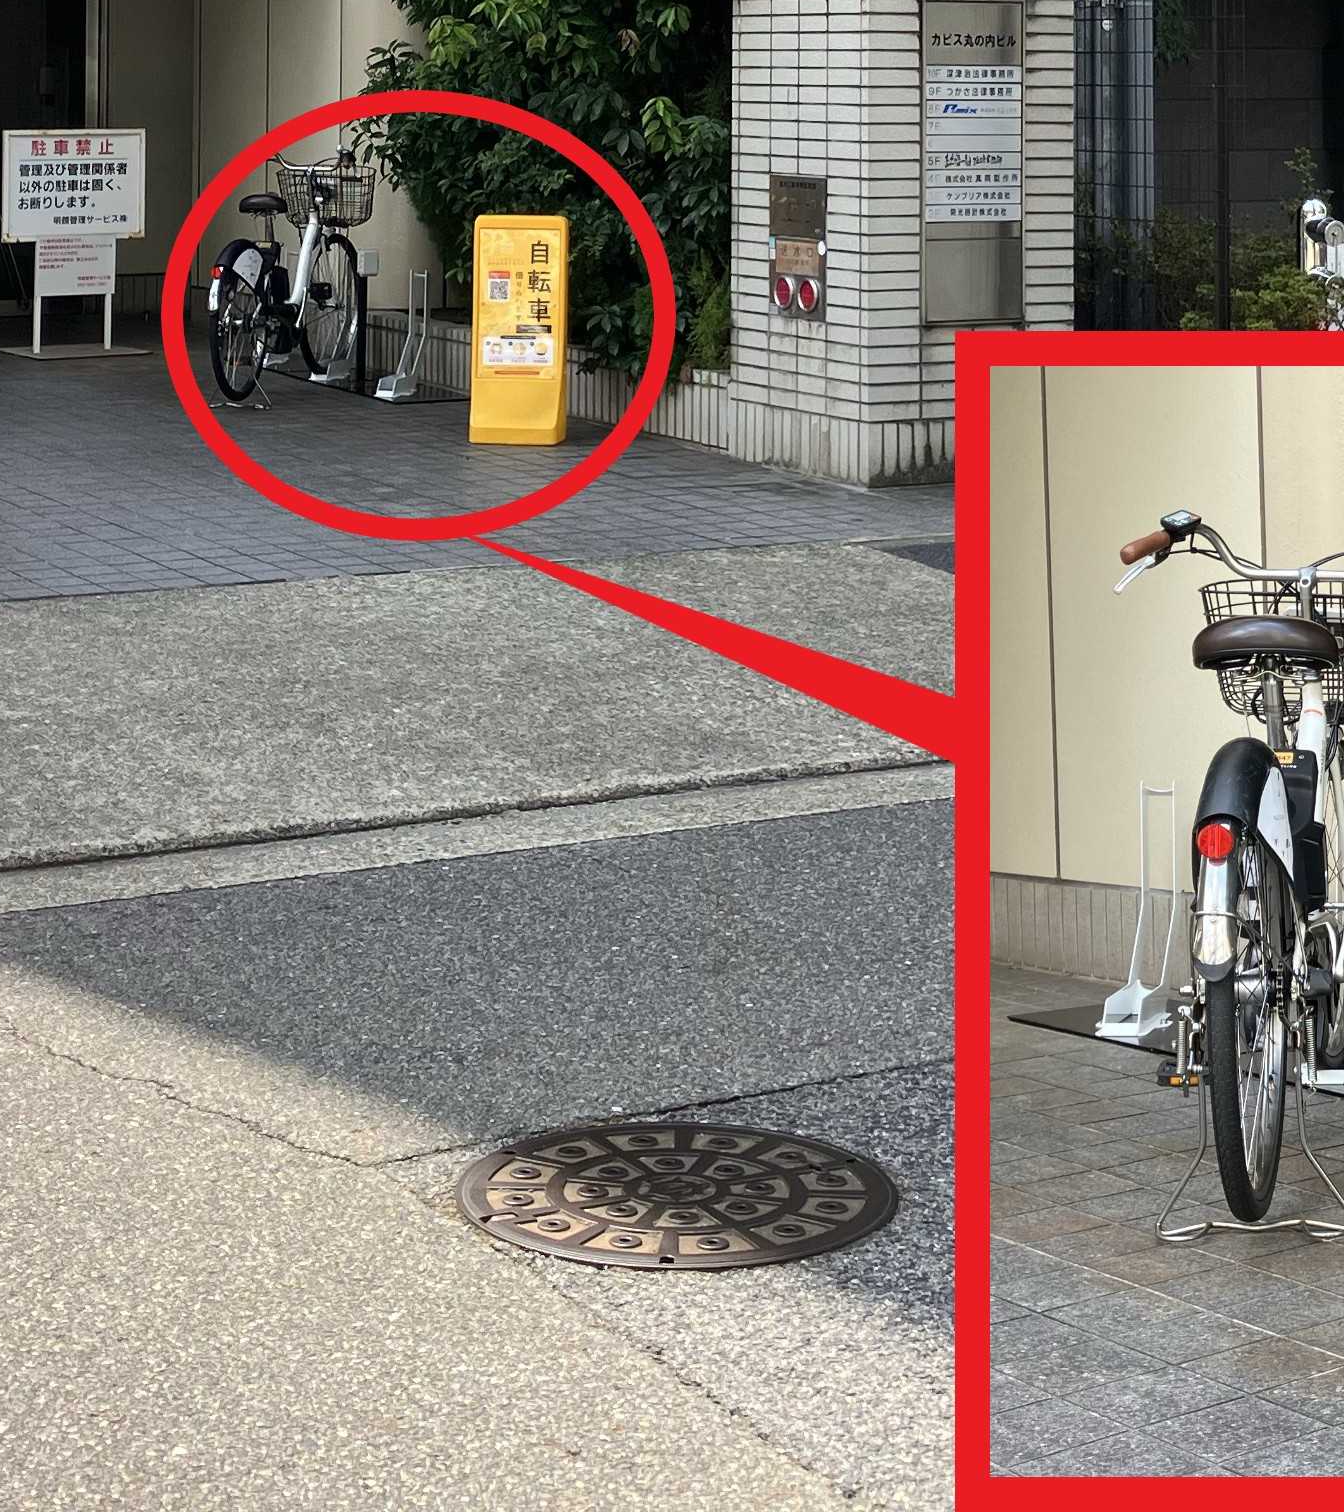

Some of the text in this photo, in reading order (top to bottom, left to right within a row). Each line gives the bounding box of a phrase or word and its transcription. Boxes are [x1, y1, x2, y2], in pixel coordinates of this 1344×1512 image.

[31, 139, 114, 156] 駐車禁止
[19, 163, 128, 177] 管理及び管理関係者
[17, 195, 96, 210] お断りします。
[527, 240, 551, 322] 自転車
